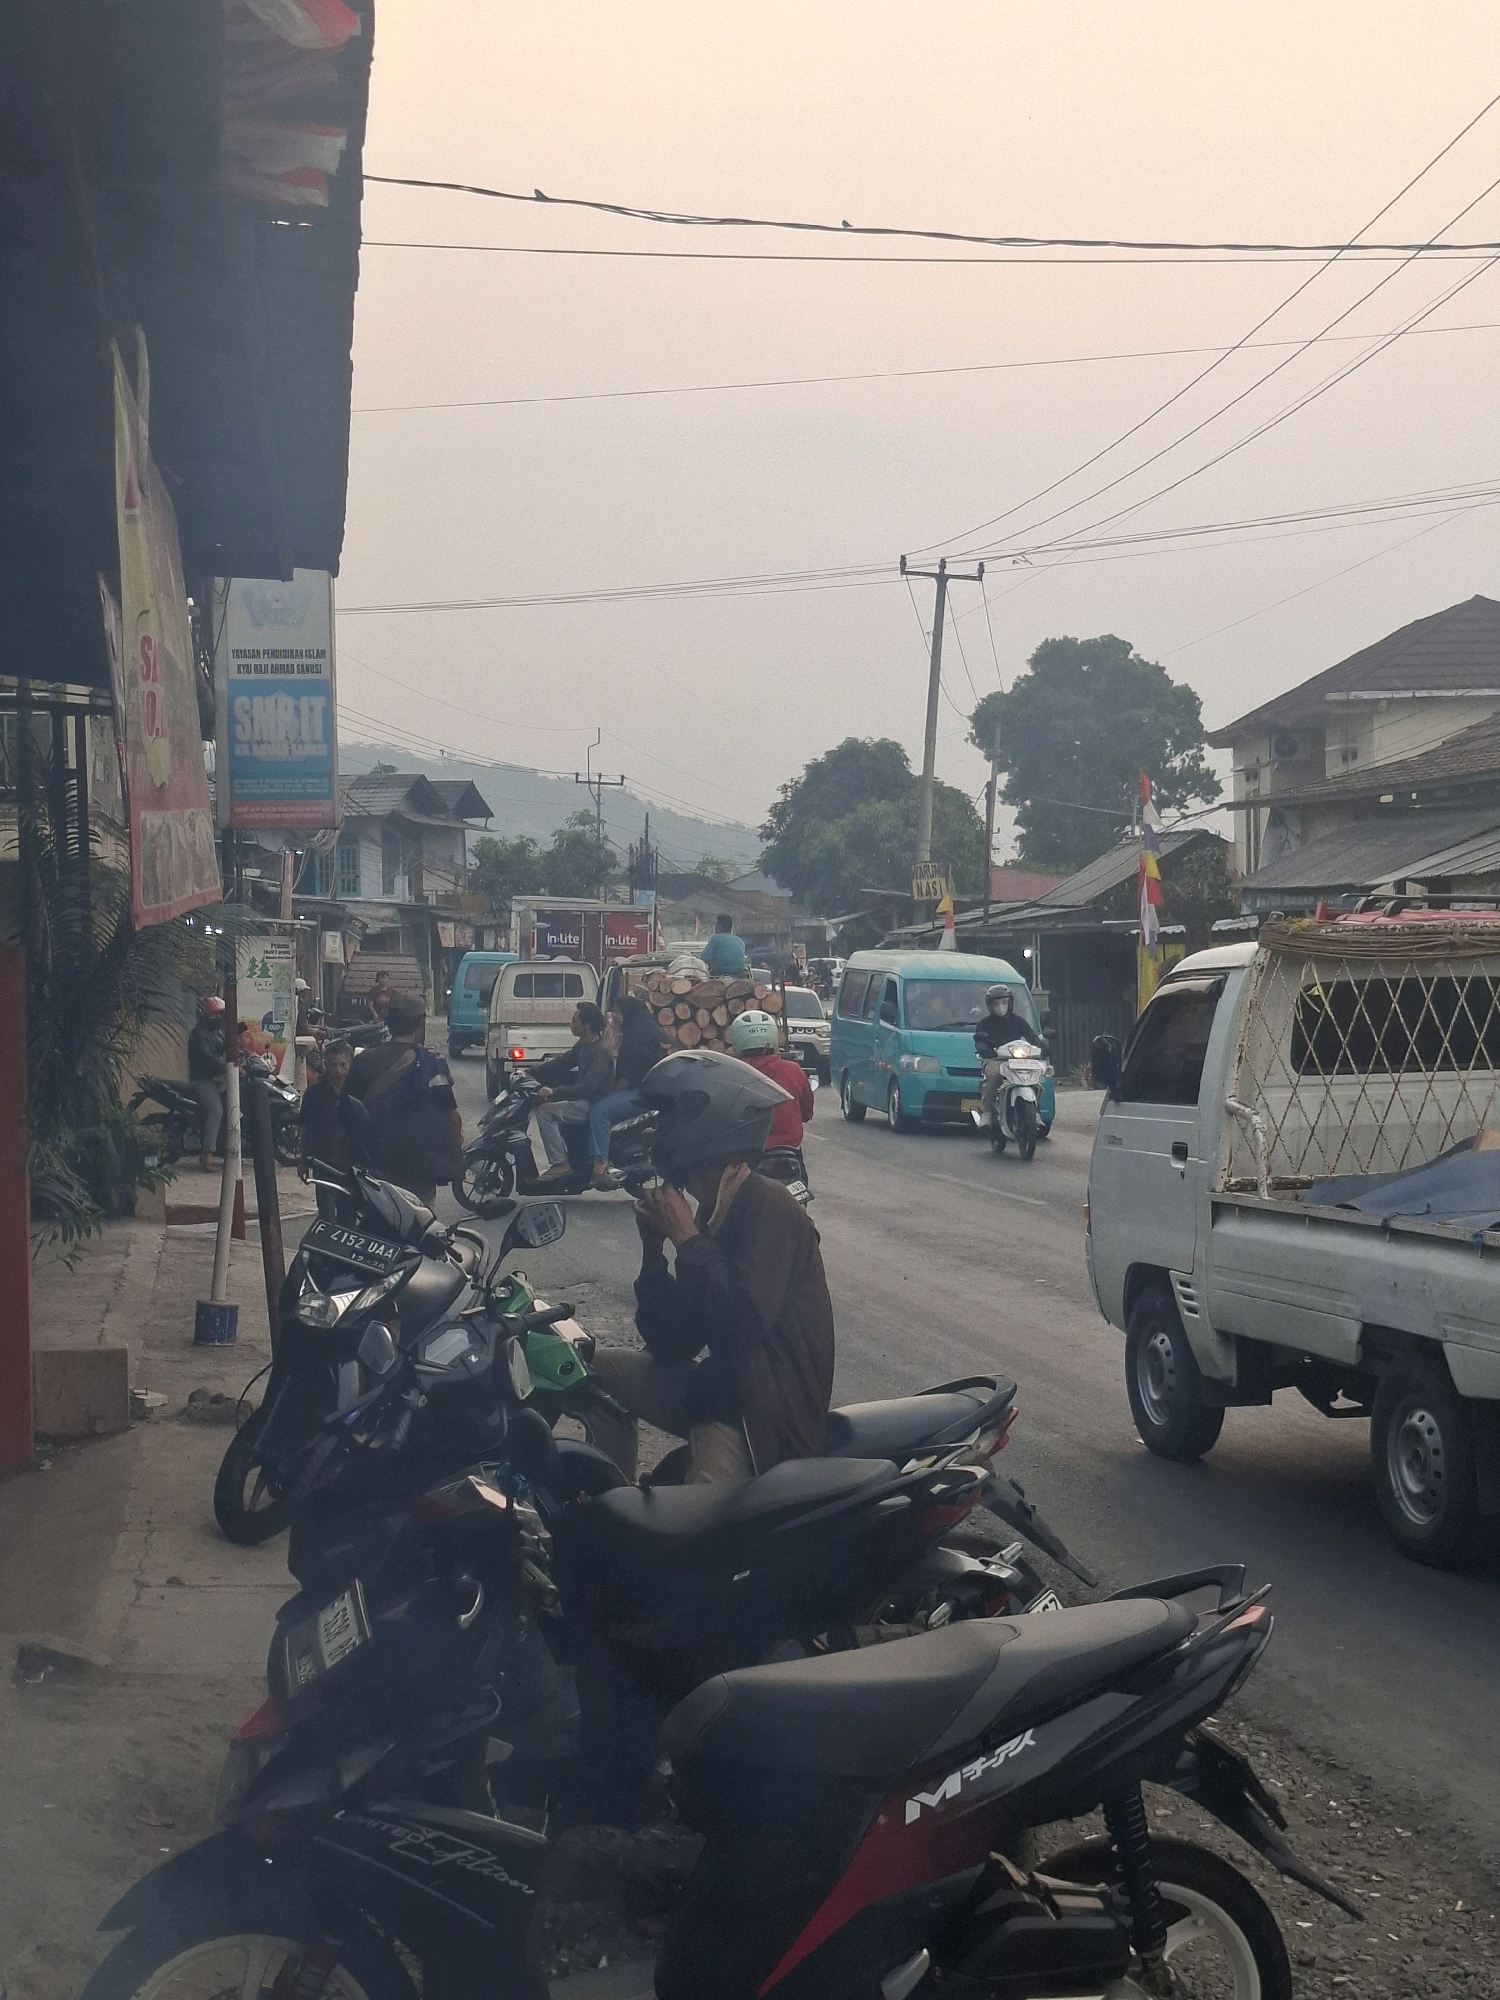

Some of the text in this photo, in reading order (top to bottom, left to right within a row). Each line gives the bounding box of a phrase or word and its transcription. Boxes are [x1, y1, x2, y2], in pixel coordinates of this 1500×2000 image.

[232, 648, 326, 659] YAYASAN PENDIDIKAN ISLAM
[270, 664, 295, 674] AHMAD
[296, 664, 322, 674] SANUSI
[314, 1223, 326, 1234] F
[367, 1241, 394, 1259] UAA
